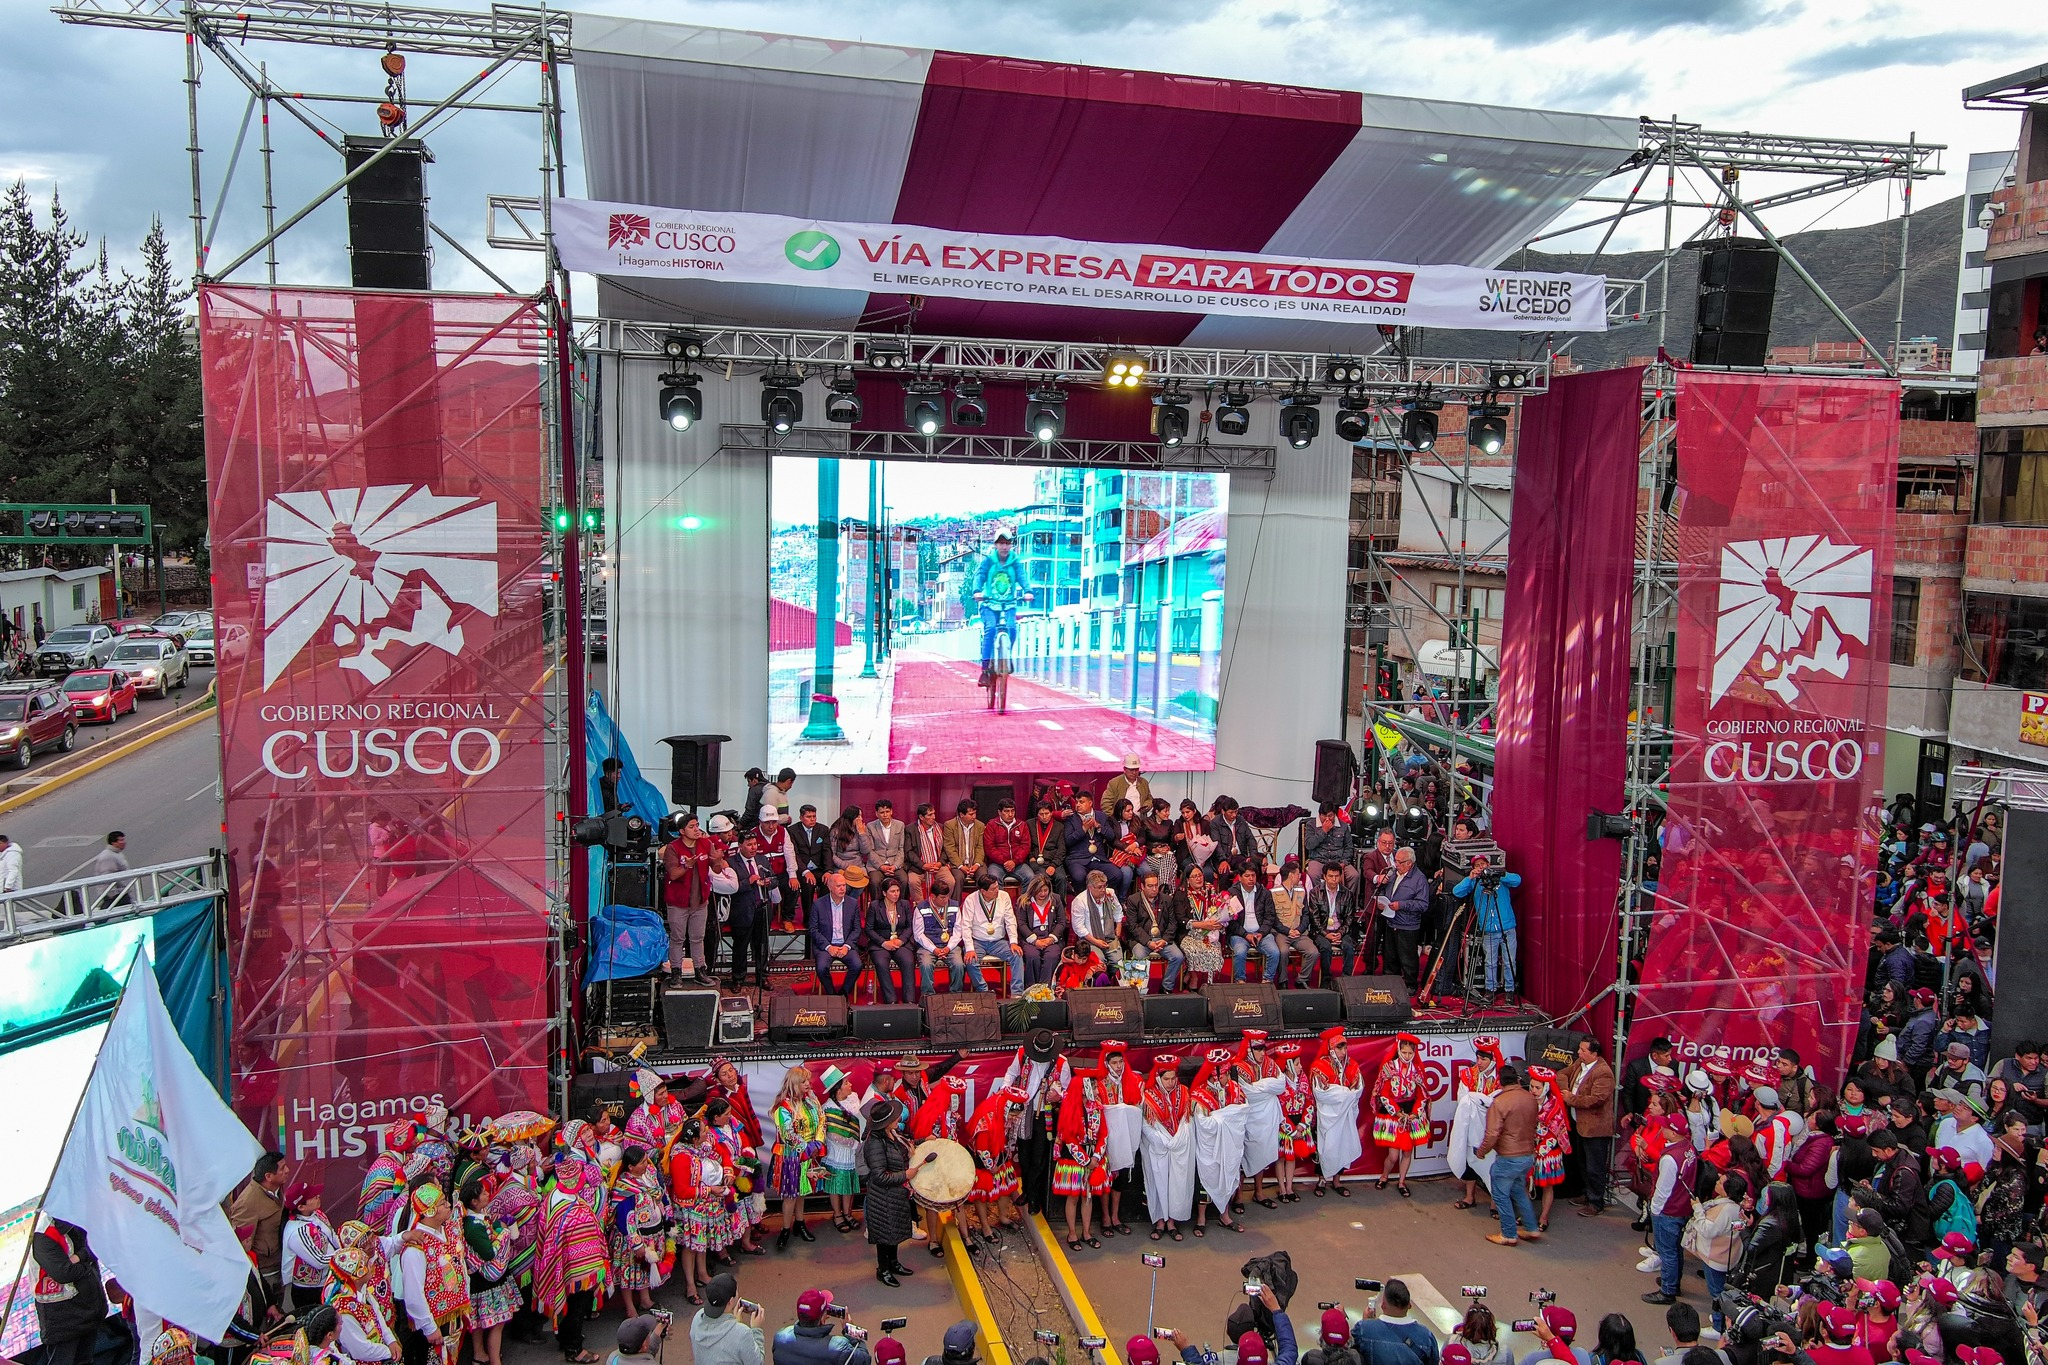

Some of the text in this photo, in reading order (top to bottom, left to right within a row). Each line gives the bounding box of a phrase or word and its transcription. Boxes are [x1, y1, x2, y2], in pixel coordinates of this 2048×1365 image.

[655, 222, 736, 234] GOBIERNO REGIONAL
[655, 232, 736, 253] CUSCO
[672, 259, 725, 271] HISTORIA
[858, 235, 1399, 298] VÍA EXPRESA PARA TODOS
[873, 272, 1406, 317] EL MEGAPROYECTO PARA EL DESARROLLO DE CUSCO ¡ES UNA REALIDAD!
[1485, 278, 1572, 297] WERNER
[1479, 295, 1571, 315] SALCEDO
[1547, 315, 1571, 323] Regional
[260, 702, 501, 722] GOBIERNO REGIONAL
[1706, 718, 1864, 735] GOBIERNO REGIONAL
[261, 726, 501, 779] CUSCO
[1703, 739, 1863, 783] CUSCO
[293, 1092, 444, 1127] Hagamos
